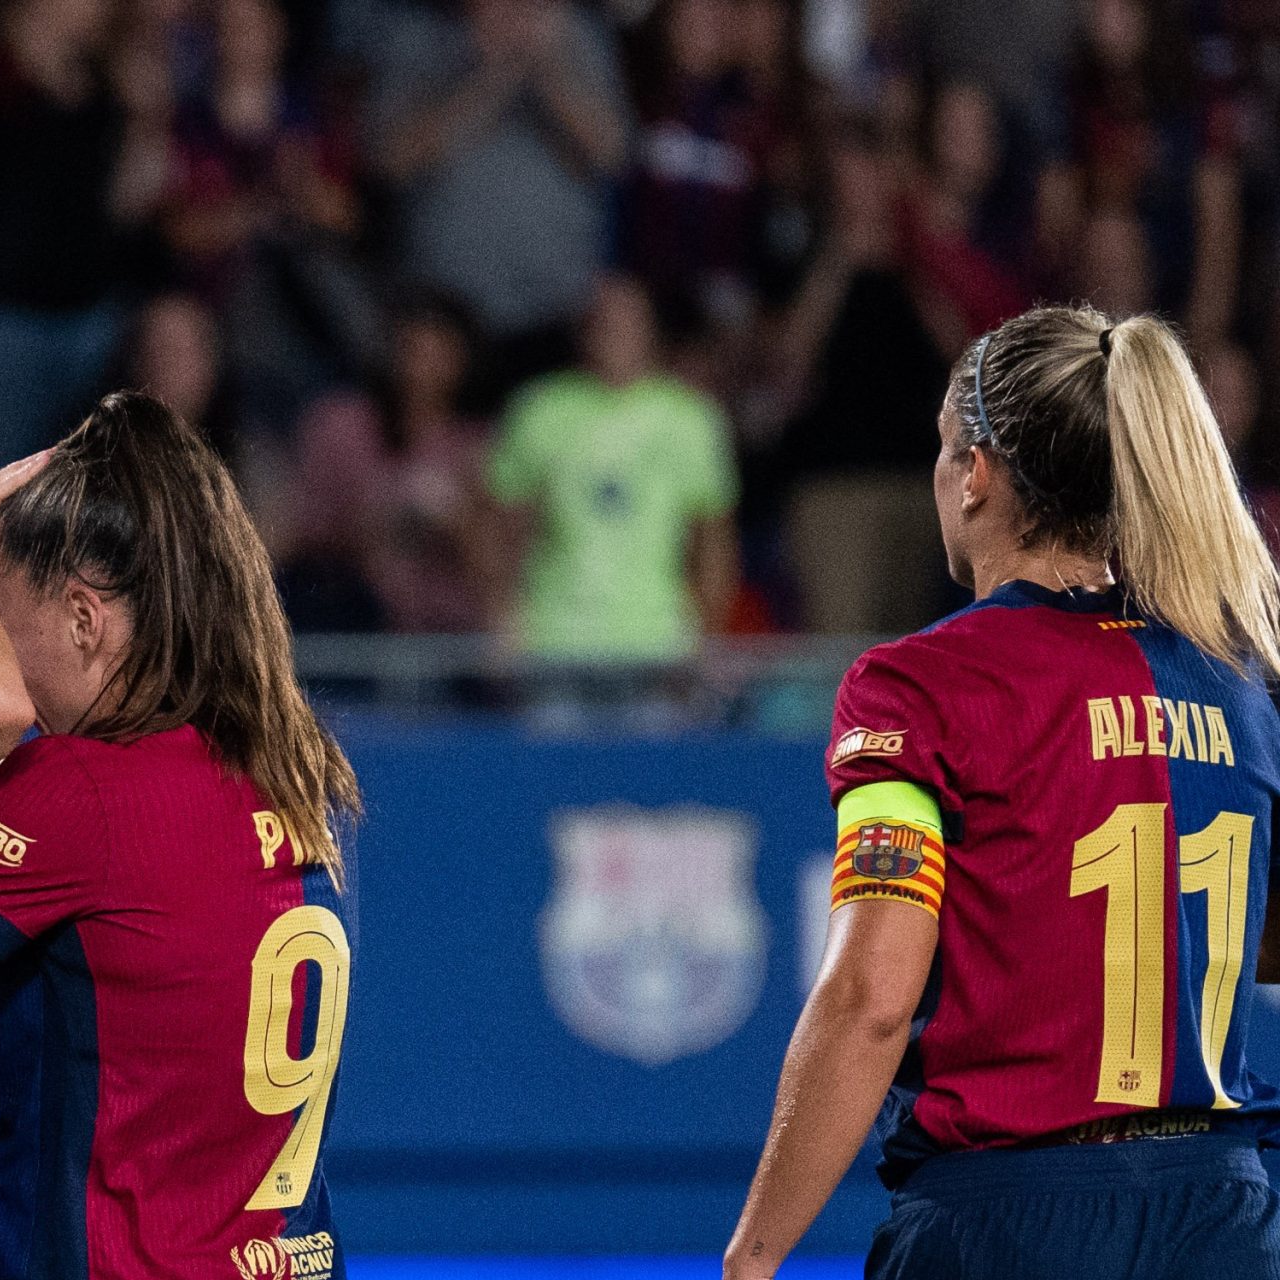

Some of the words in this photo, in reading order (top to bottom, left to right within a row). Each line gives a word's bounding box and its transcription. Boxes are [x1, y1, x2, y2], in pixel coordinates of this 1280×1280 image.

[831, 731, 904, 765] BIMBO
[1087, 696, 1236, 767] ALEXIA
[842, 883, 926, 905] CAPITANA
[1069, 802, 1256, 1110] 11
[243, 904, 351, 1211] 9
[278, 1231, 335, 1254] UNHCR
[290, 1248, 334, 1276] ACNU
